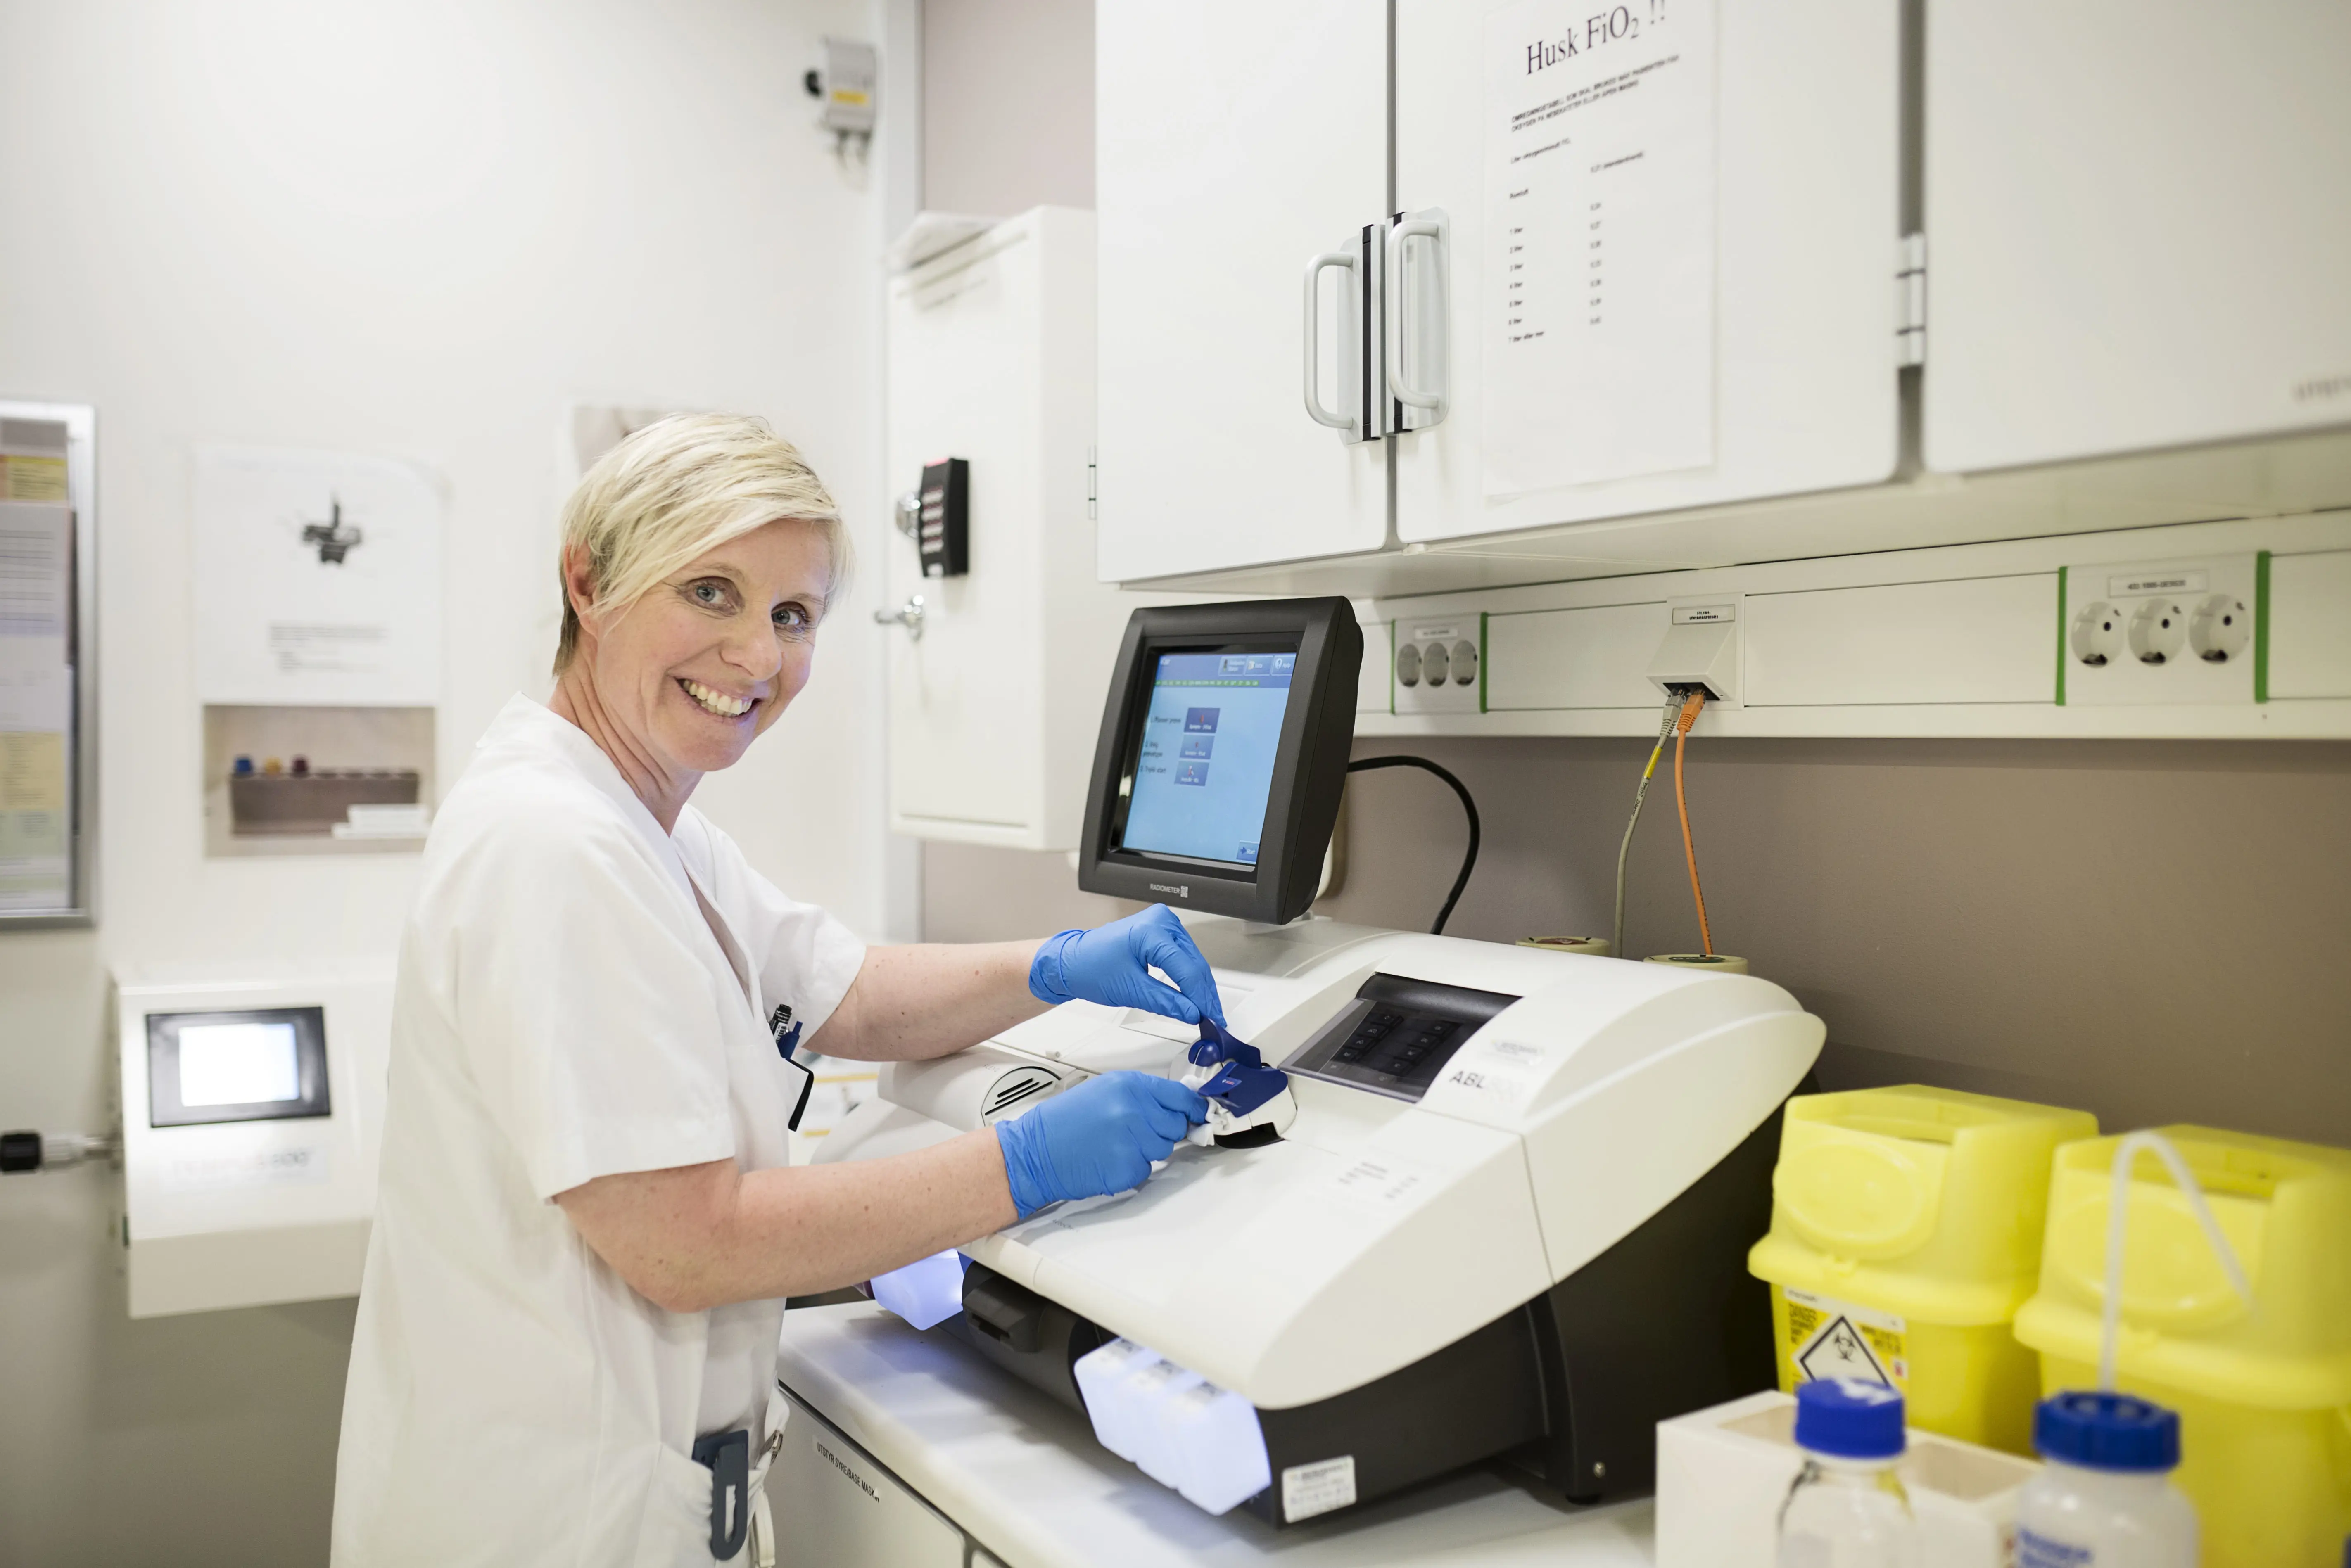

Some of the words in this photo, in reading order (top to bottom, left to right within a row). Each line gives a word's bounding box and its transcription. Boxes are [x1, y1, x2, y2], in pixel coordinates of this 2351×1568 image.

[1527, 28, 1579, 75] Husk
[1150, 883, 1180, 894] RADIOMETER
[817, 1442, 834, 1464] UTSTYR
[835, 1457, 860, 1487] SYRE/BASE
[862, 1480, 879, 1503] MASK
